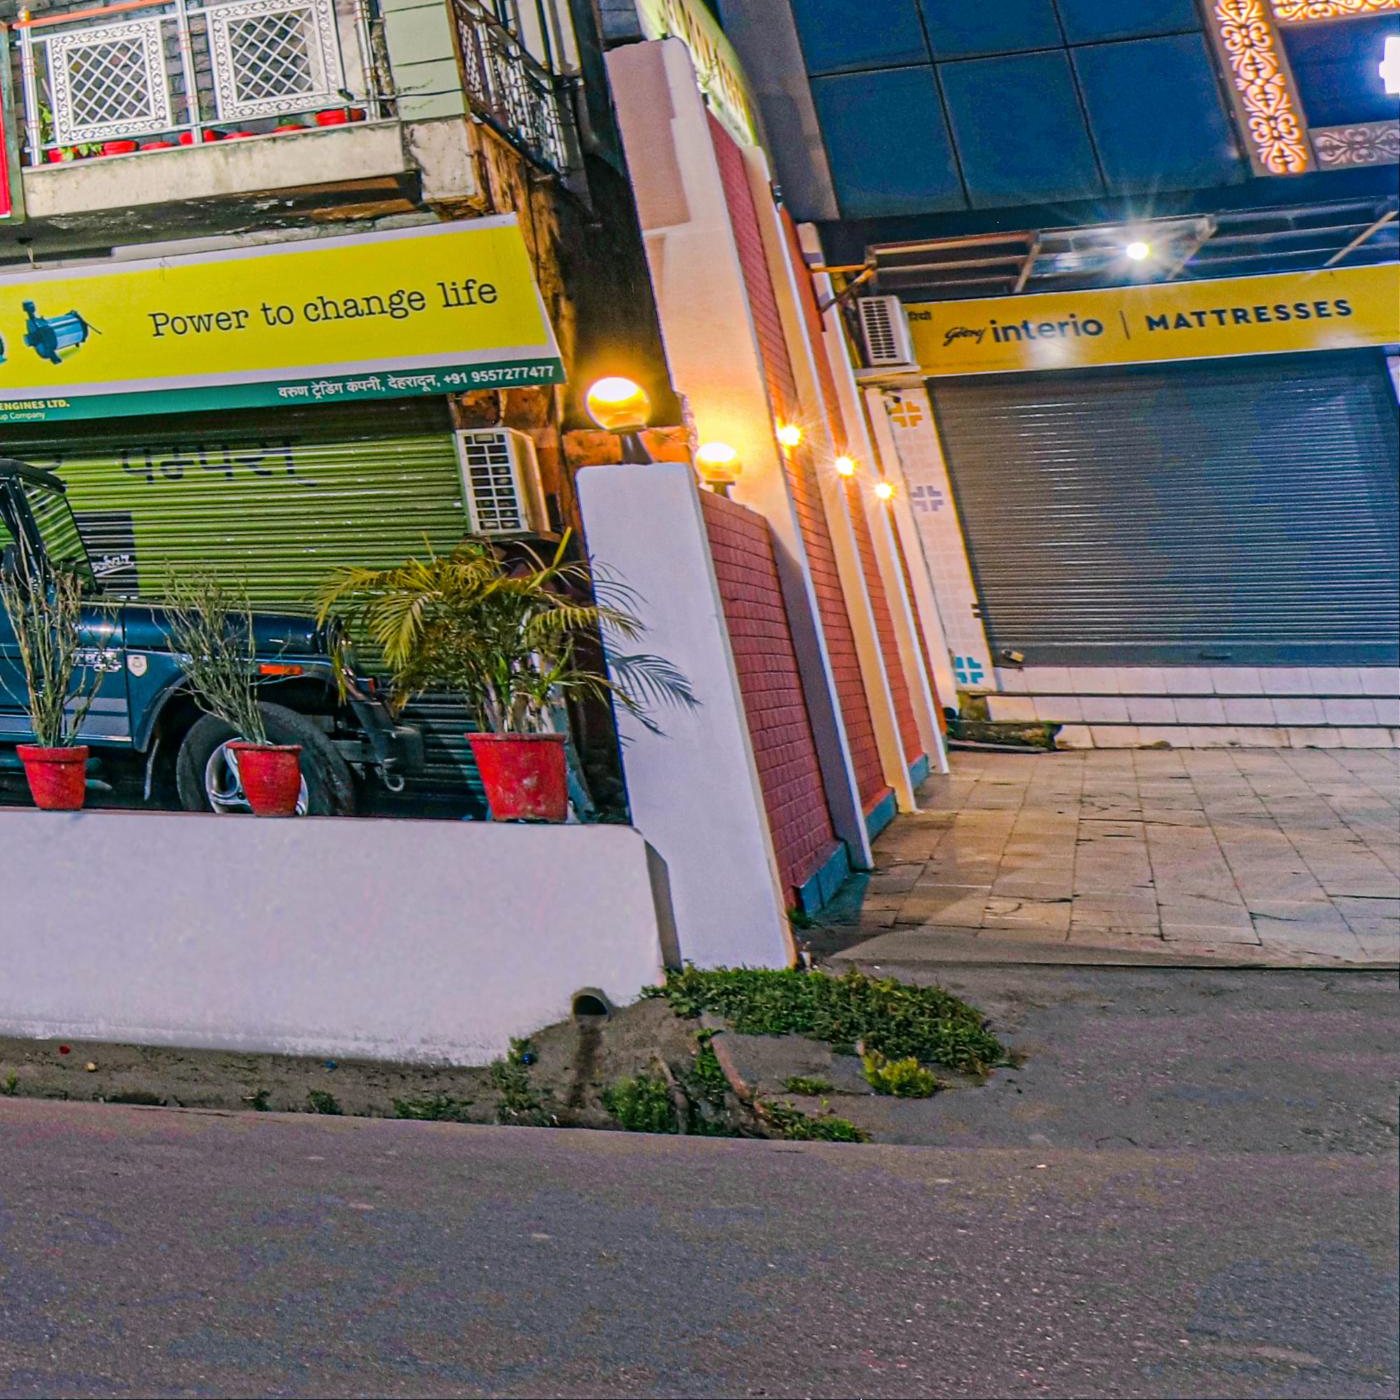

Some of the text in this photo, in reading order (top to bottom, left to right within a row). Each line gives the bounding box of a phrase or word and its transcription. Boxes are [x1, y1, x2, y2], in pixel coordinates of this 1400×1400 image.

[148, 279, 498, 338] Power to change life
[990, 313, 1104, 343] interio
[1145, 299, 1352, 332] MATTRESSES
[443, 373, 468, 385] +91
[471, 365, 555, 383] 9557277477
[48, 399, 70, 409] LTD.
[10, 411, 46, 421] Company
